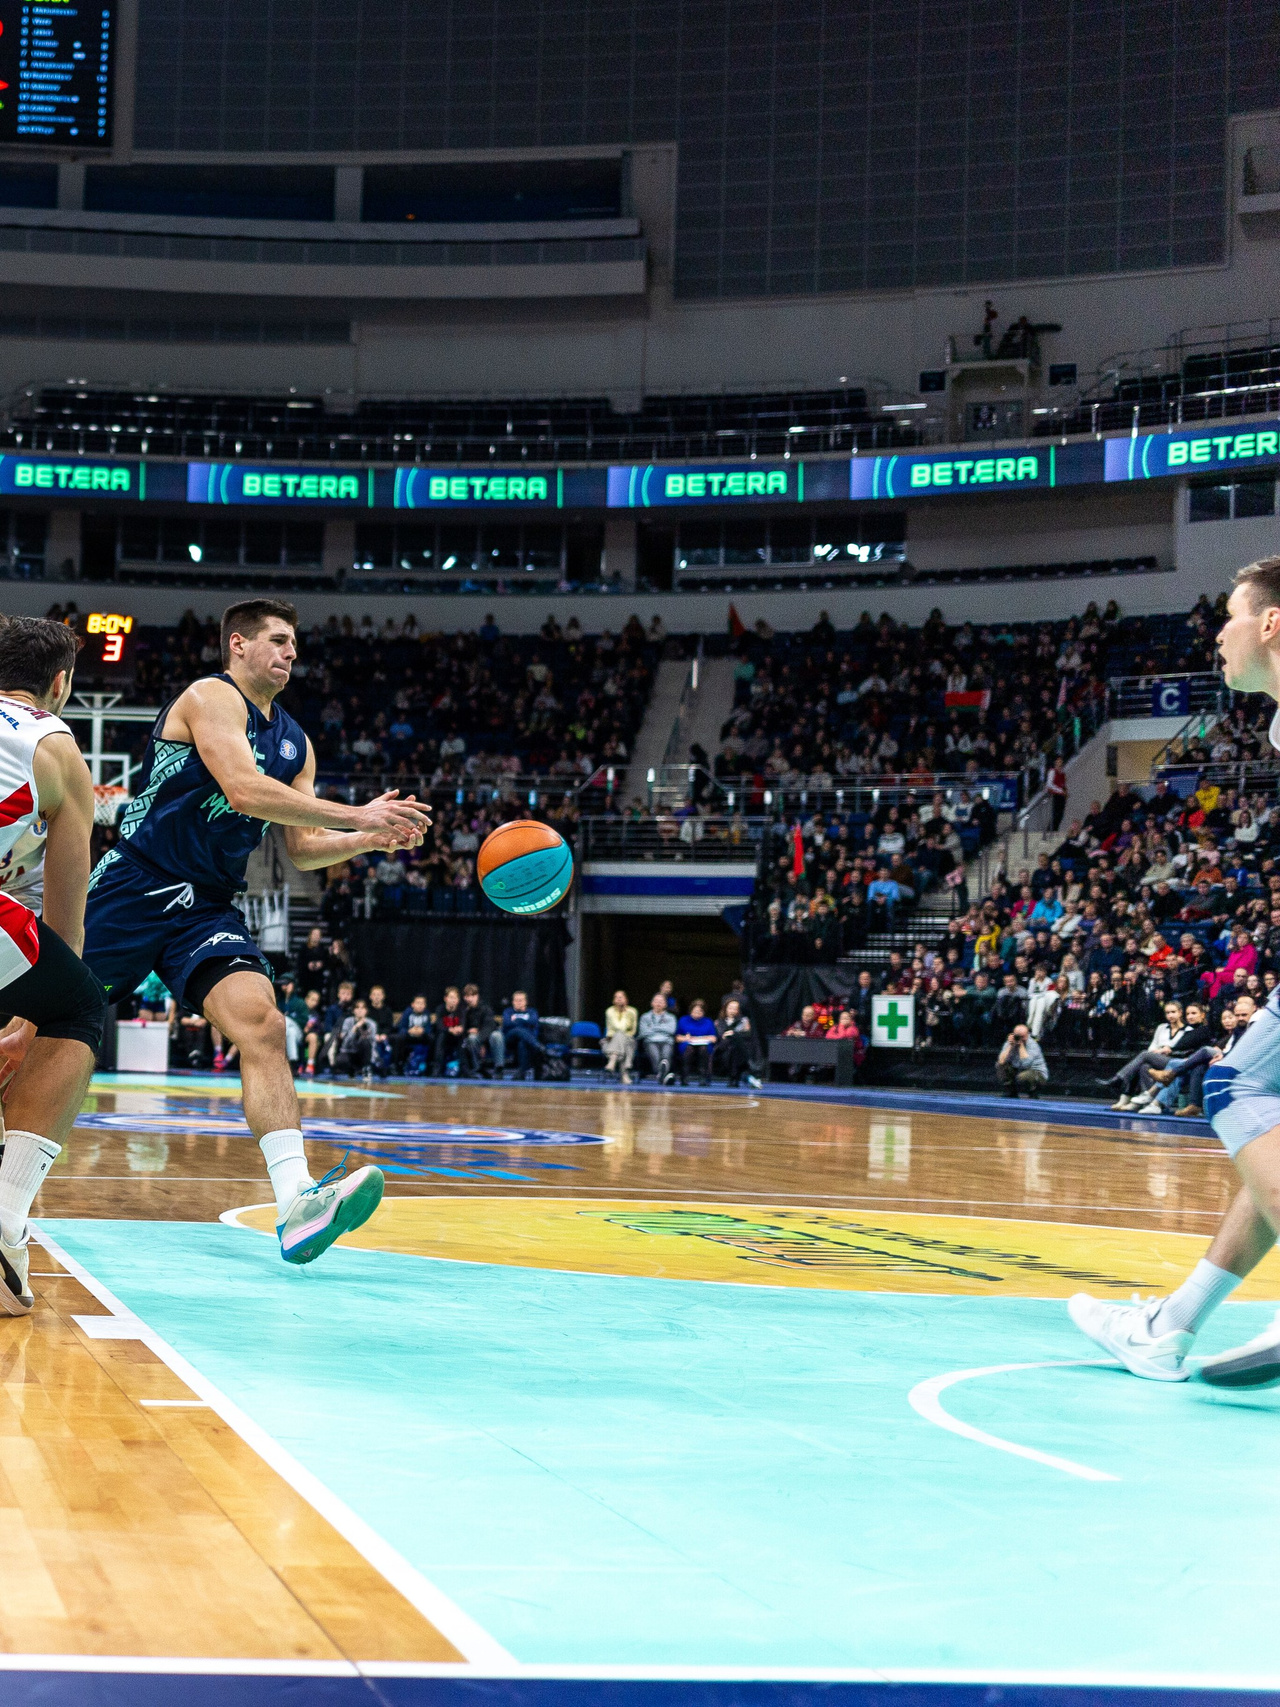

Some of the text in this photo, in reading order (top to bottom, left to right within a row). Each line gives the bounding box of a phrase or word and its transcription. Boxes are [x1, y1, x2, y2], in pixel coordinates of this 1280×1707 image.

[87, 613, 133, 634] 8:04
[102, 634, 125, 662] 3
[511, 887, 562, 913] SIBUR
